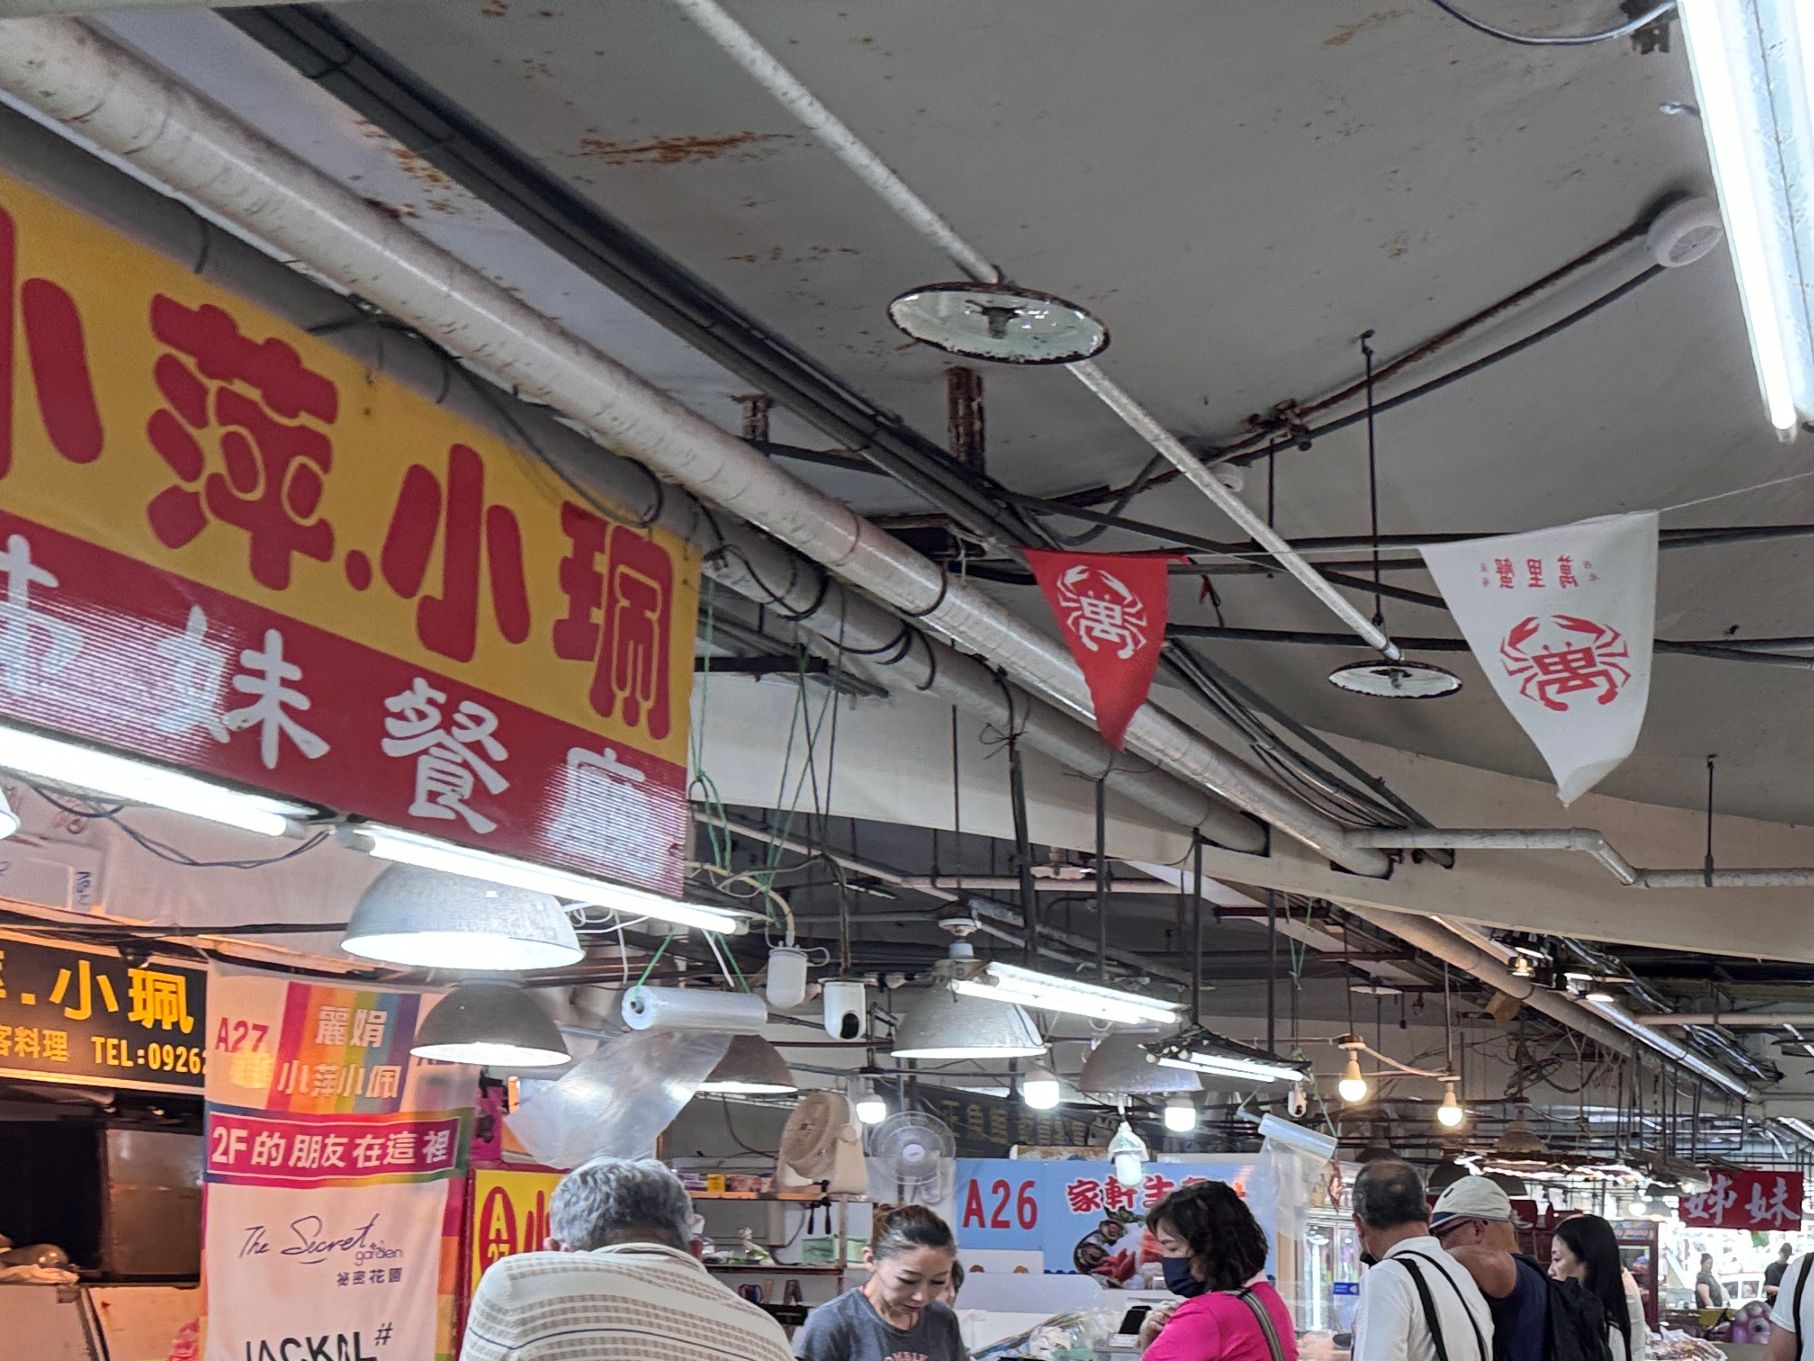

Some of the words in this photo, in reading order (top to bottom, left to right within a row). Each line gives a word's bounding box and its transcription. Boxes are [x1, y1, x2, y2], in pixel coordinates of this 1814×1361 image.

[0, 950, 195, 1035] .小珮
[214, 1016, 270, 1053] A27
[316, 1004, 388, 1048] 麗娟
[961, 1177, 1038, 1231] A26
[238, 1225, 270, 1259] The
[280, 1213, 381, 1259] Secret
